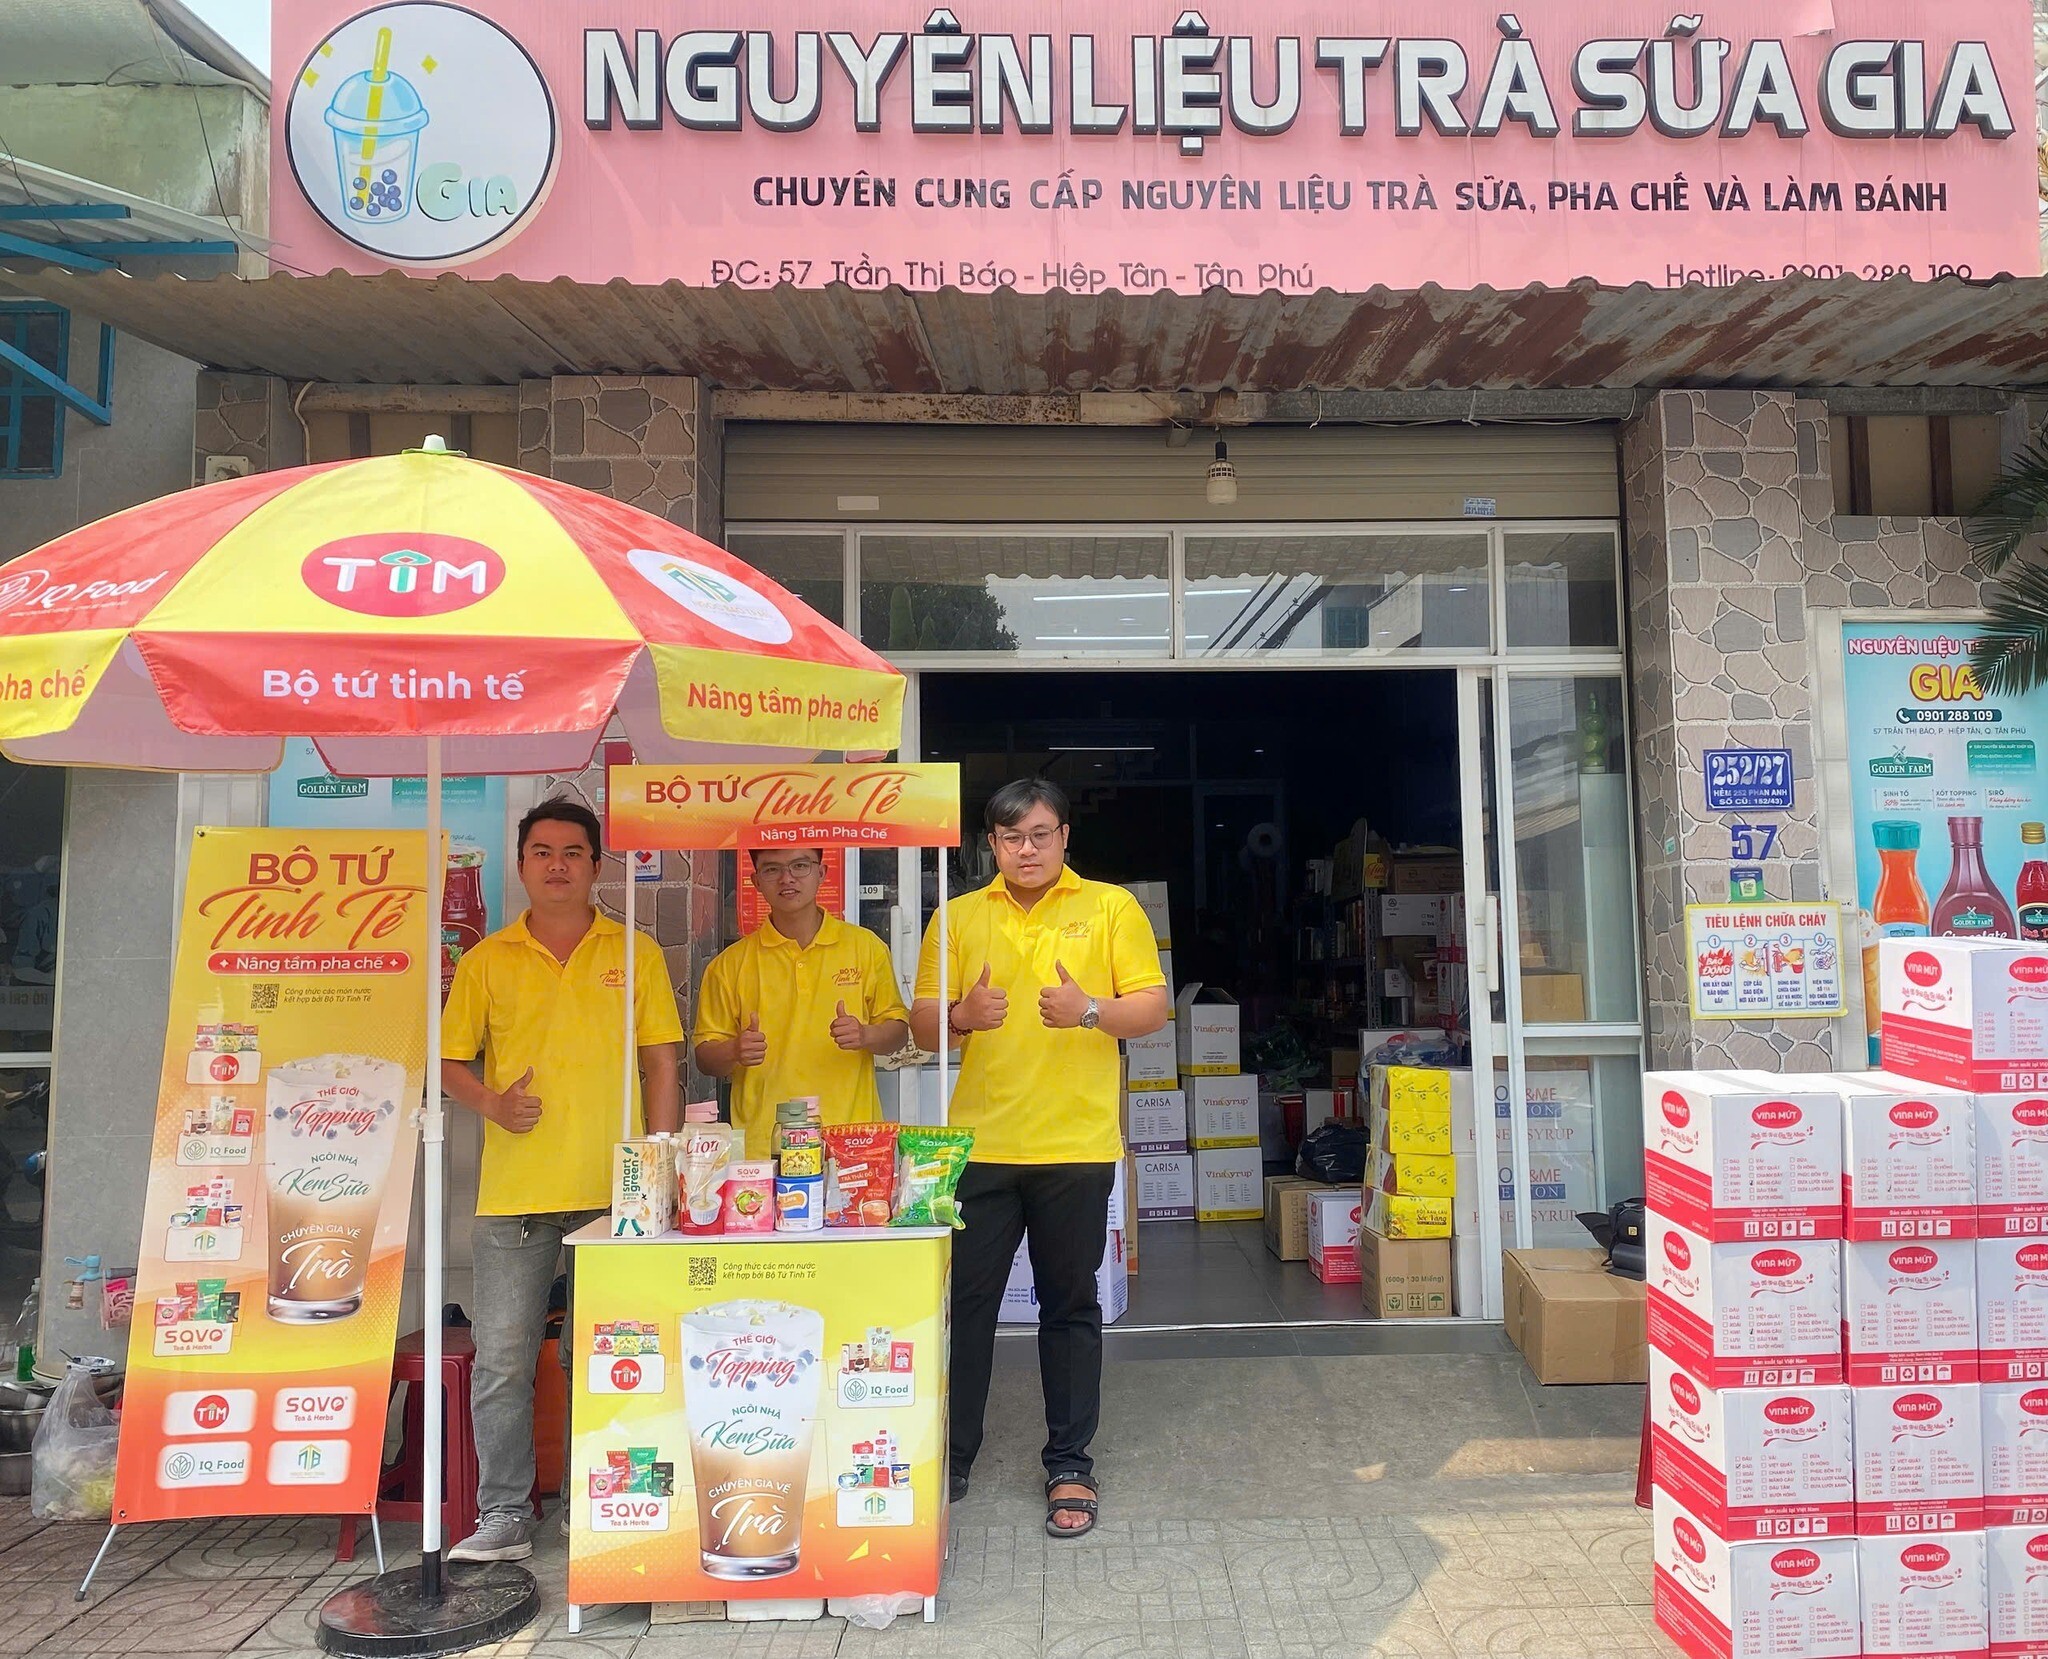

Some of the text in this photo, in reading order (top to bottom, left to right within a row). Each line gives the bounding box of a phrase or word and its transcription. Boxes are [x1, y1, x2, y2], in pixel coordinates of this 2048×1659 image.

[583, 8, 2016, 157] NGUYÊN LIỆU TRÀ SỮA GIA
[753, 168, 1947, 214] CHUYÊN CUNG CẤP NGUYÊN LIỆU TRÀ SỮA, PHA CHẾ VÀ LÀM BÁNH
[779, 260, 812, 285] 57
[830, 252, 892, 286] Trần
[1119, 262, 1168, 288] Tân
[1194, 262, 1244, 288] Tân
[1258, 263, 1313, 288] Phú
[71, 569, 169, 601] Food
[1848, 635, 1922, 655] NGUYÊN
[1922, 635, 1960, 659] LIỆU
[40, 664, 89, 698] chế
[262, 668, 528, 705] Bộ tứ tinh tế
[1909, 663, 1985, 702] GIA
[688, 682, 880, 723] Nâng tầm pha chế
[1916, 710, 1993, 721] 0901 288 109
[1712, 755, 1786, 785] 252/27
[1871, 763, 1932, 774] GOLDEN FARM
[299, 782, 367, 794] GOLDEN FARM
[645, 771, 923, 825] BỘ TỨ Tinh Tế
[1719, 797, 1733, 805] SỐ
[760, 824, 888, 842] Nâng Tầm Pha Chế
[1732, 824, 1778, 860] 57
[248, 845, 395, 893] BỘ TỨ
[198, 885, 428, 951] Tinh Tế
[1733, 912, 1762, 931] LỆNH
[1765, 912, 1796, 927] CHỮA
[1798, 911, 1827, 927] CHÁY
[1953, 918, 1976, 926] GOLDEN
[1784, 936, 1789, 944] 3
[1817, 935, 1823, 943] 4
[236, 954, 384, 973] Nâng tầm pha chế
[1703, 965, 1731, 978] ĐỘNG
[317, 1085, 360, 1098] THẾ GIỚI
[1135, 1098, 1171, 1107] CARISA
[289, 1099, 377, 1138] Topping
[1756, 1111, 1777, 1120] VINA
[1893, 1111, 1914, 1119] VINA
[224, 1146, 247, 1154] Food
[686, 1139, 720, 1155] Lion
[311, 1152, 358, 1167] NGÔI NHÀ
[1144, 1163, 1180, 1173] CARISA
[622, 1158, 632, 1193] smart
[631, 1158, 641, 1192] green
[280, 1223, 362, 1245] CHUYÊN GIA VỀ
[281, 1238, 355, 1290] Trà
[1755, 1259, 1776, 1267] VINA
[1893, 1257, 1914, 1265] VINA
[733, 1333, 776, 1346] THẾ GIỚI
[706, 1348, 796, 1389] Topping
[885, 1383, 908, 1394] Food
[732, 1404, 782, 1420] NGÔI NHÀ
[1768, 1407, 1789, 1415] VINA
[216, 1458, 244, 1470] Food
[708, 1477, 792, 1499] CHUYÊN GIA VỀ
[711, 1492, 790, 1546] Trà
